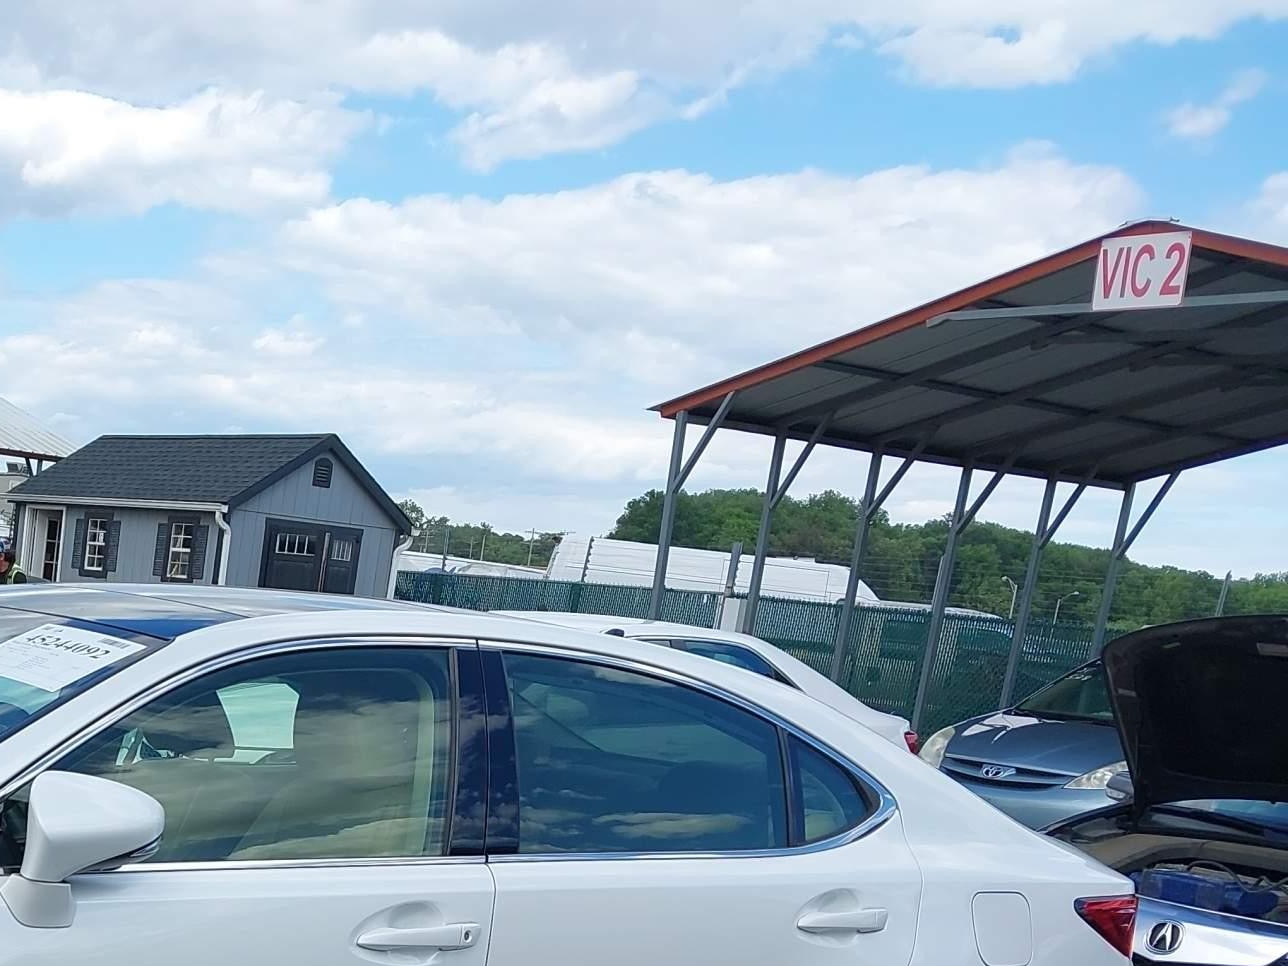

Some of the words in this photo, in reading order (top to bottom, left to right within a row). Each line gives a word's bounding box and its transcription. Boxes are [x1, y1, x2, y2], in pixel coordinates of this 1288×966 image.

[1101, 243, 1156, 299] VIC
[1158, 242, 1186, 295] 2
[25, 634, 111, 659] 45244092
